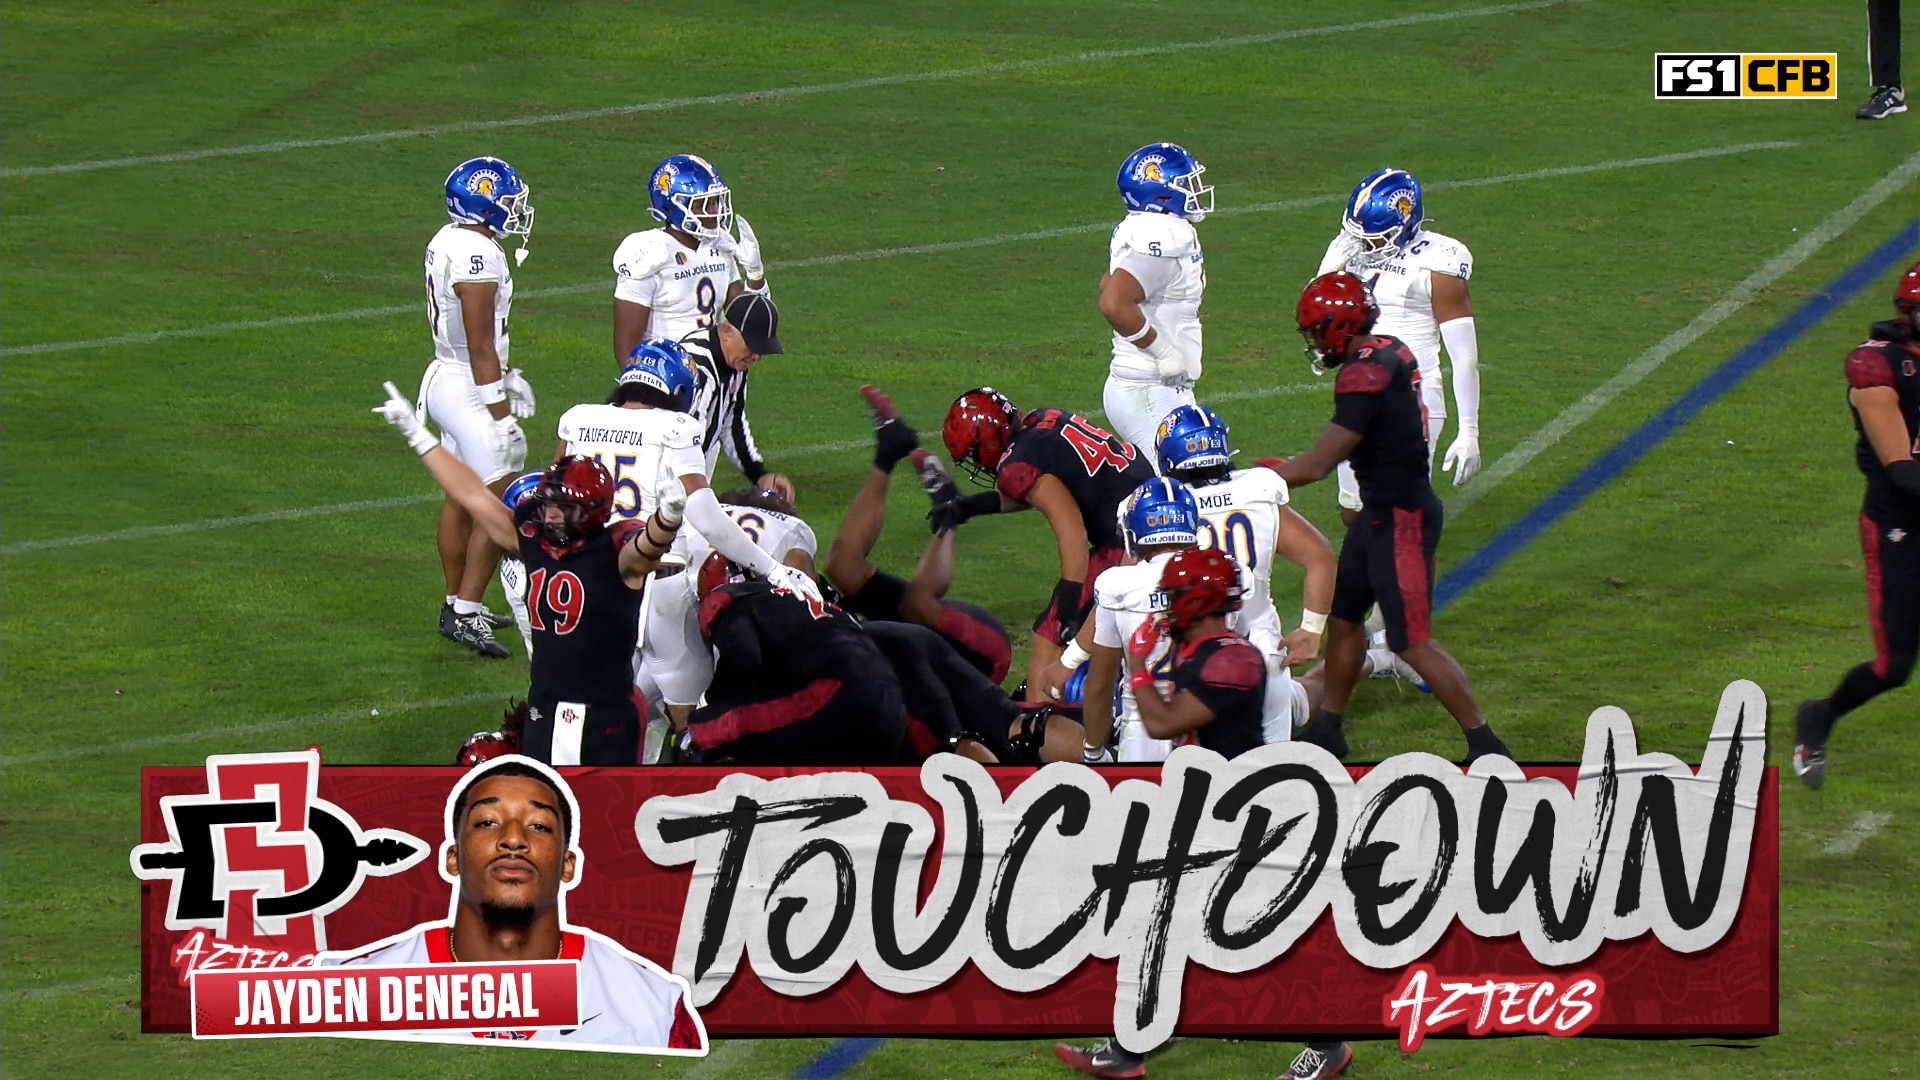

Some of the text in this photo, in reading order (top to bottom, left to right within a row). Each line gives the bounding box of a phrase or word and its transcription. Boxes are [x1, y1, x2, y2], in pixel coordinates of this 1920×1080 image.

[674, 269, 692, 280] SAN
[709, 262, 726, 273] STATE
[1384, 263, 1406, 275] STATE
[695, 275, 716, 329] 9
[578, 427, 643, 447] TAUFATOFUA
[1183, 458, 1197, 469] SAN
[1199, 493, 1233, 509] MOE
[1144, 536, 1157, 544] SAN
[527, 567, 585, 635] 19
[1148, 591, 1170, 609] PO
